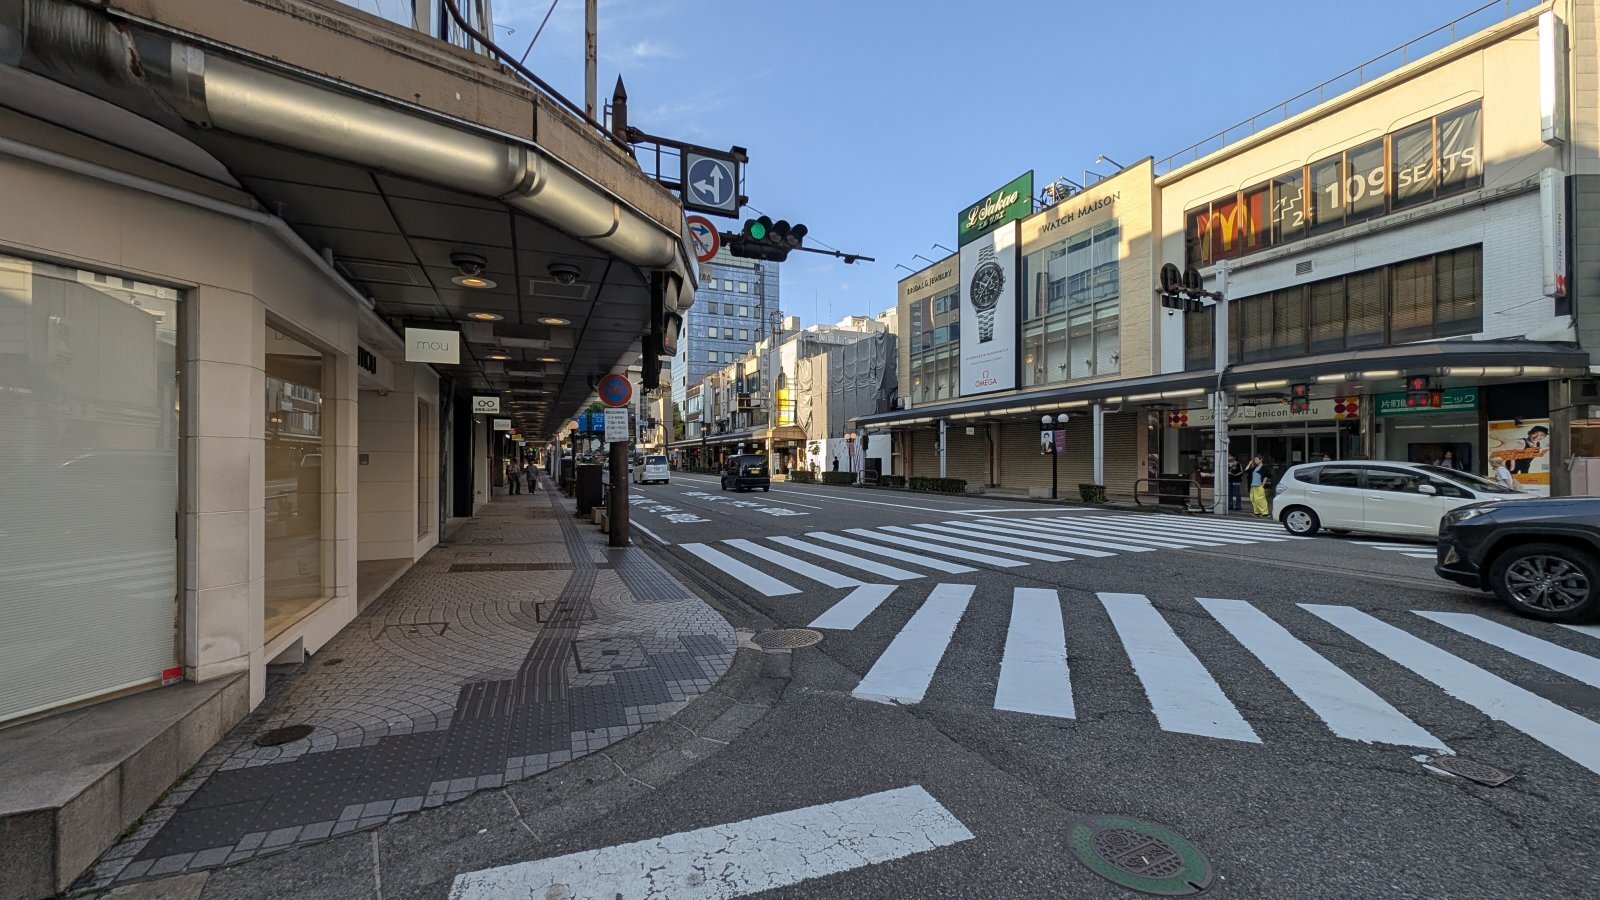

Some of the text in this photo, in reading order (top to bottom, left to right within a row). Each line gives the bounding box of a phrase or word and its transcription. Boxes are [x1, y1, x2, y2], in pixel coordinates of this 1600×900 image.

[1325, 147, 1475, 209] 109 SEATS
[978, 191, 1018, 221] Sakae
[1042, 191, 1121, 234] WATCH MAISON
[906, 281, 925, 296] BRIDAL
[929, 269, 953, 288] JEWELRY
[417, 340, 449, 352] mou
[975, 378, 998, 388] OMEGA
[1257, 409, 1288, 418] enicon
